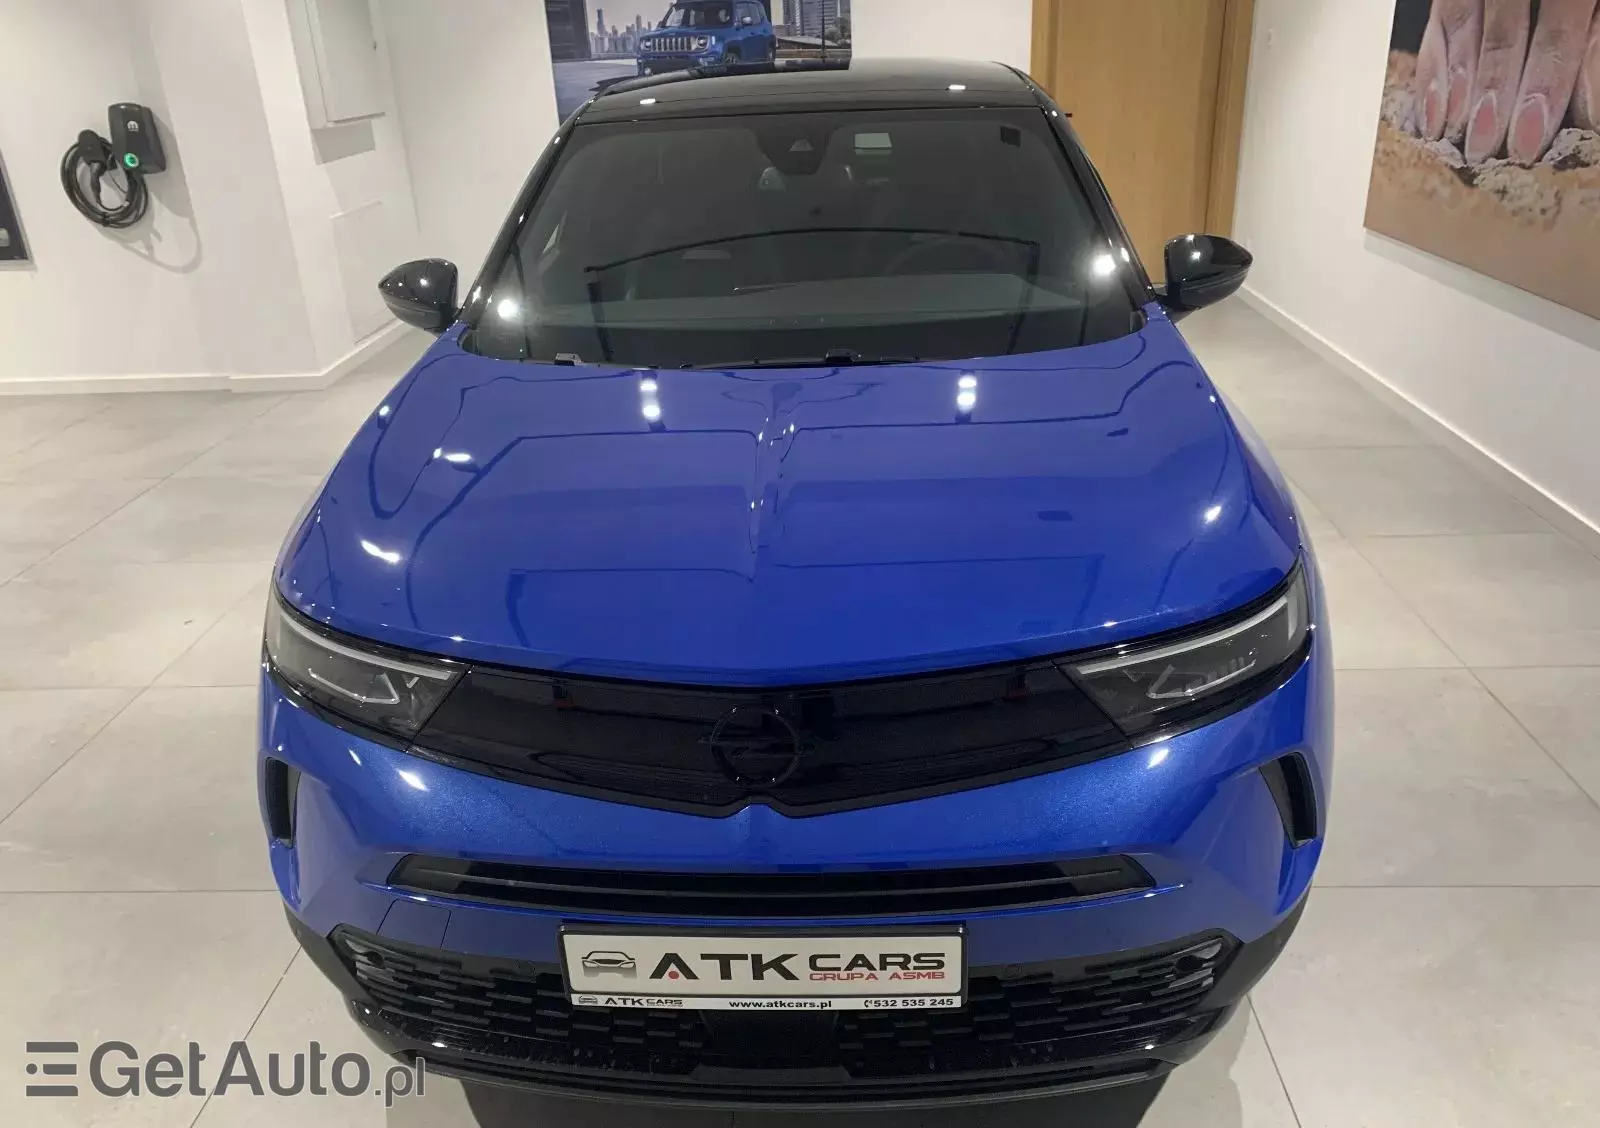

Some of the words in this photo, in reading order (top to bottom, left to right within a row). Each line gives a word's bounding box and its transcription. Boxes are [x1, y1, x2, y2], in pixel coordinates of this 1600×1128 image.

[649, 953, 800, 981] ATK
[808, 952, 945, 971] CARS
[809, 972, 878, 981] GRUPA
[889, 971, 945, 980] ASMB
[604, 997, 644, 1006] ATK
[729, 1000, 832, 1009] www.atkcars.pl
[874, 999, 900, 1007] 532
[902, 999, 925, 1007] 535
[929, 998, 954, 1006] 245
